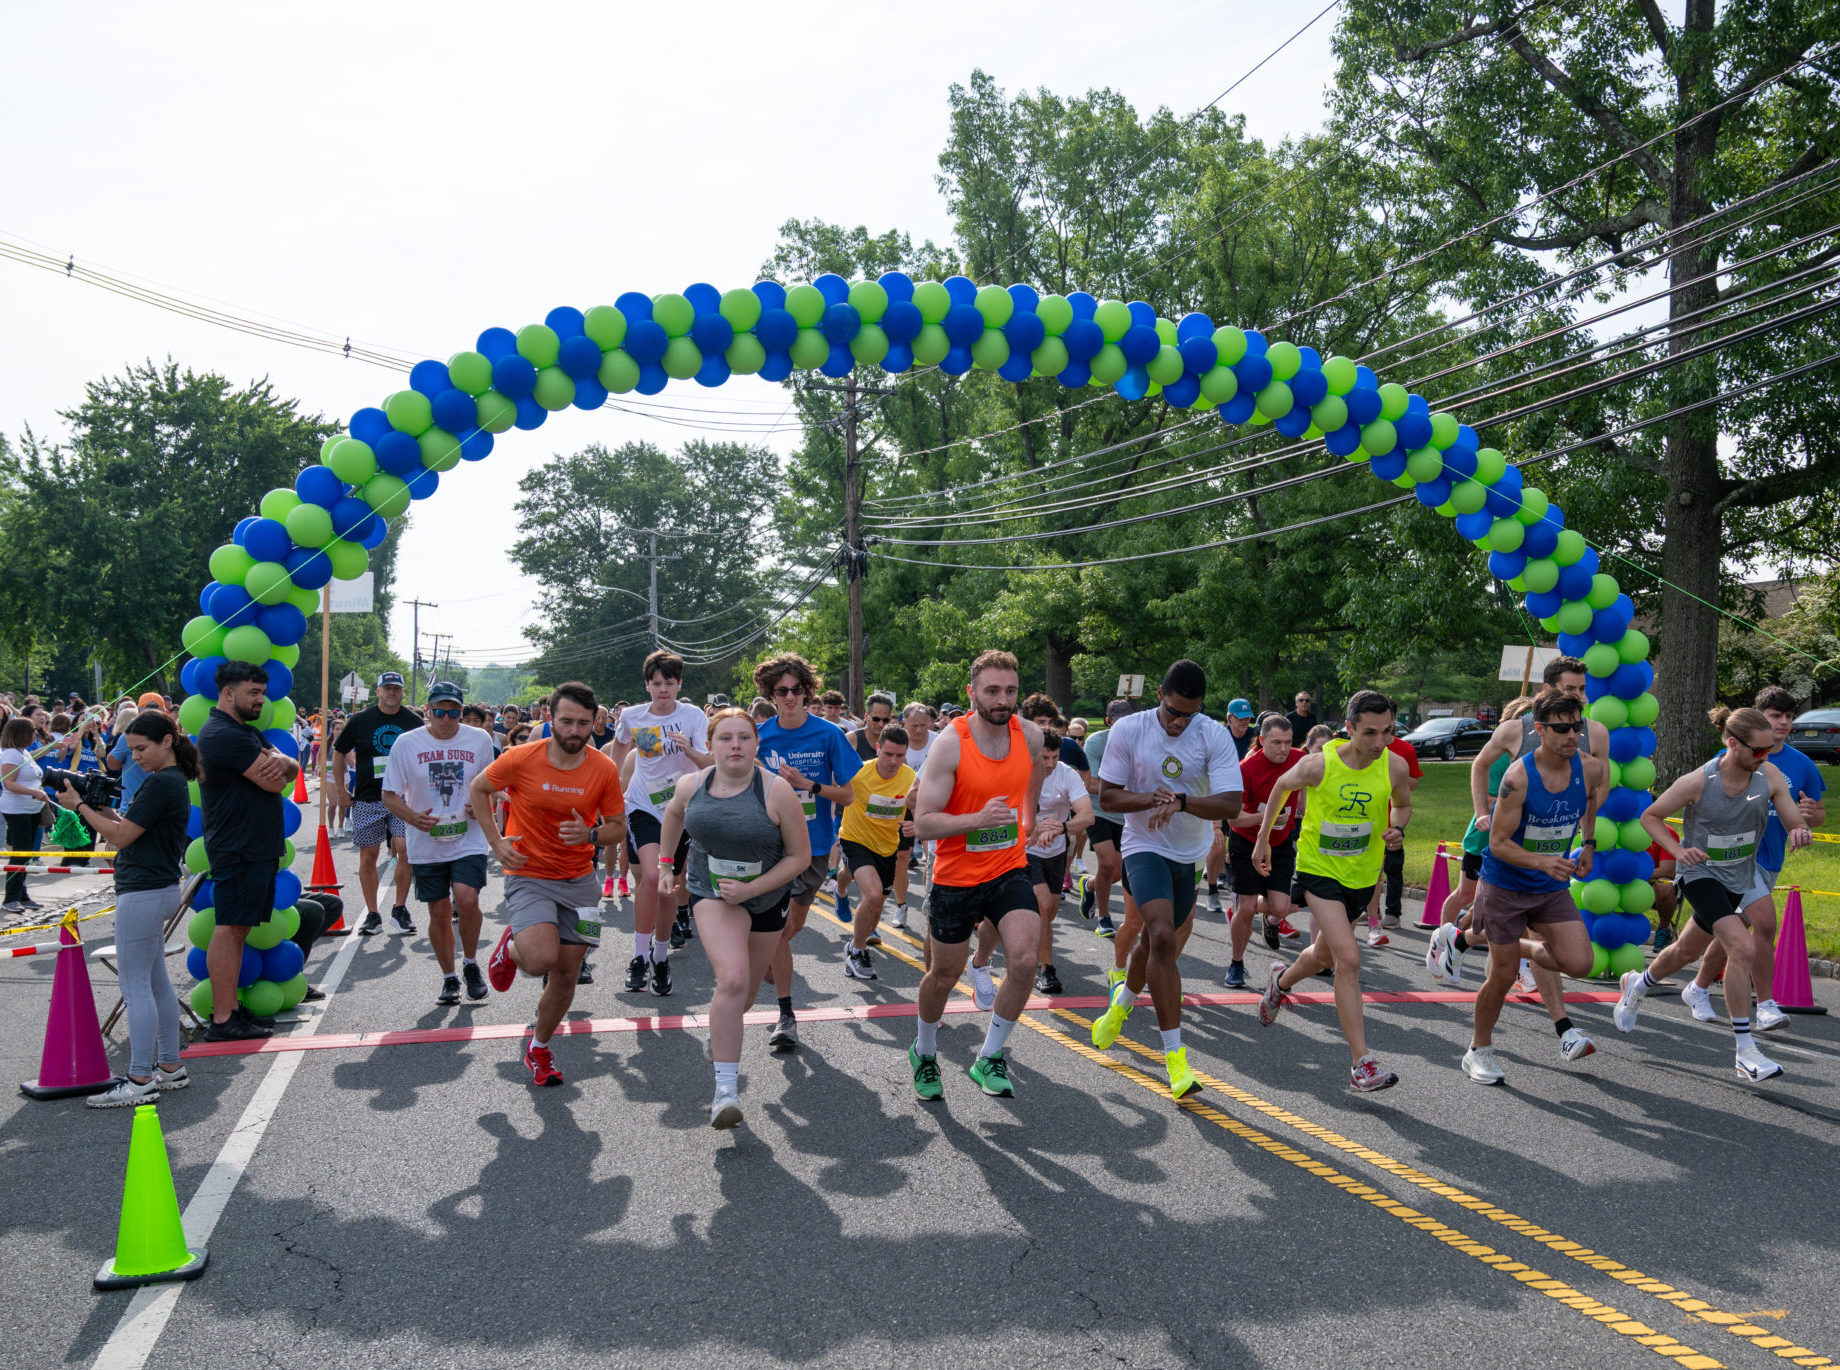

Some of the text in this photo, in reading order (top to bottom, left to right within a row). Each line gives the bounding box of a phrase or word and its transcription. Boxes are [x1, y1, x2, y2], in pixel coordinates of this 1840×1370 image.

[662, 721, 682, 738] VAN
[417, 749, 475, 764] TEAM SUSIE
[788, 751, 825, 760] University
[552, 784, 584, 796] Running
[439, 824, 459, 836] 247
[979, 829, 1008, 843] 884
[1331, 838, 1360, 849] 647
[1536, 841, 1561, 851] 150
[1723, 849, 1741, 859] 181
